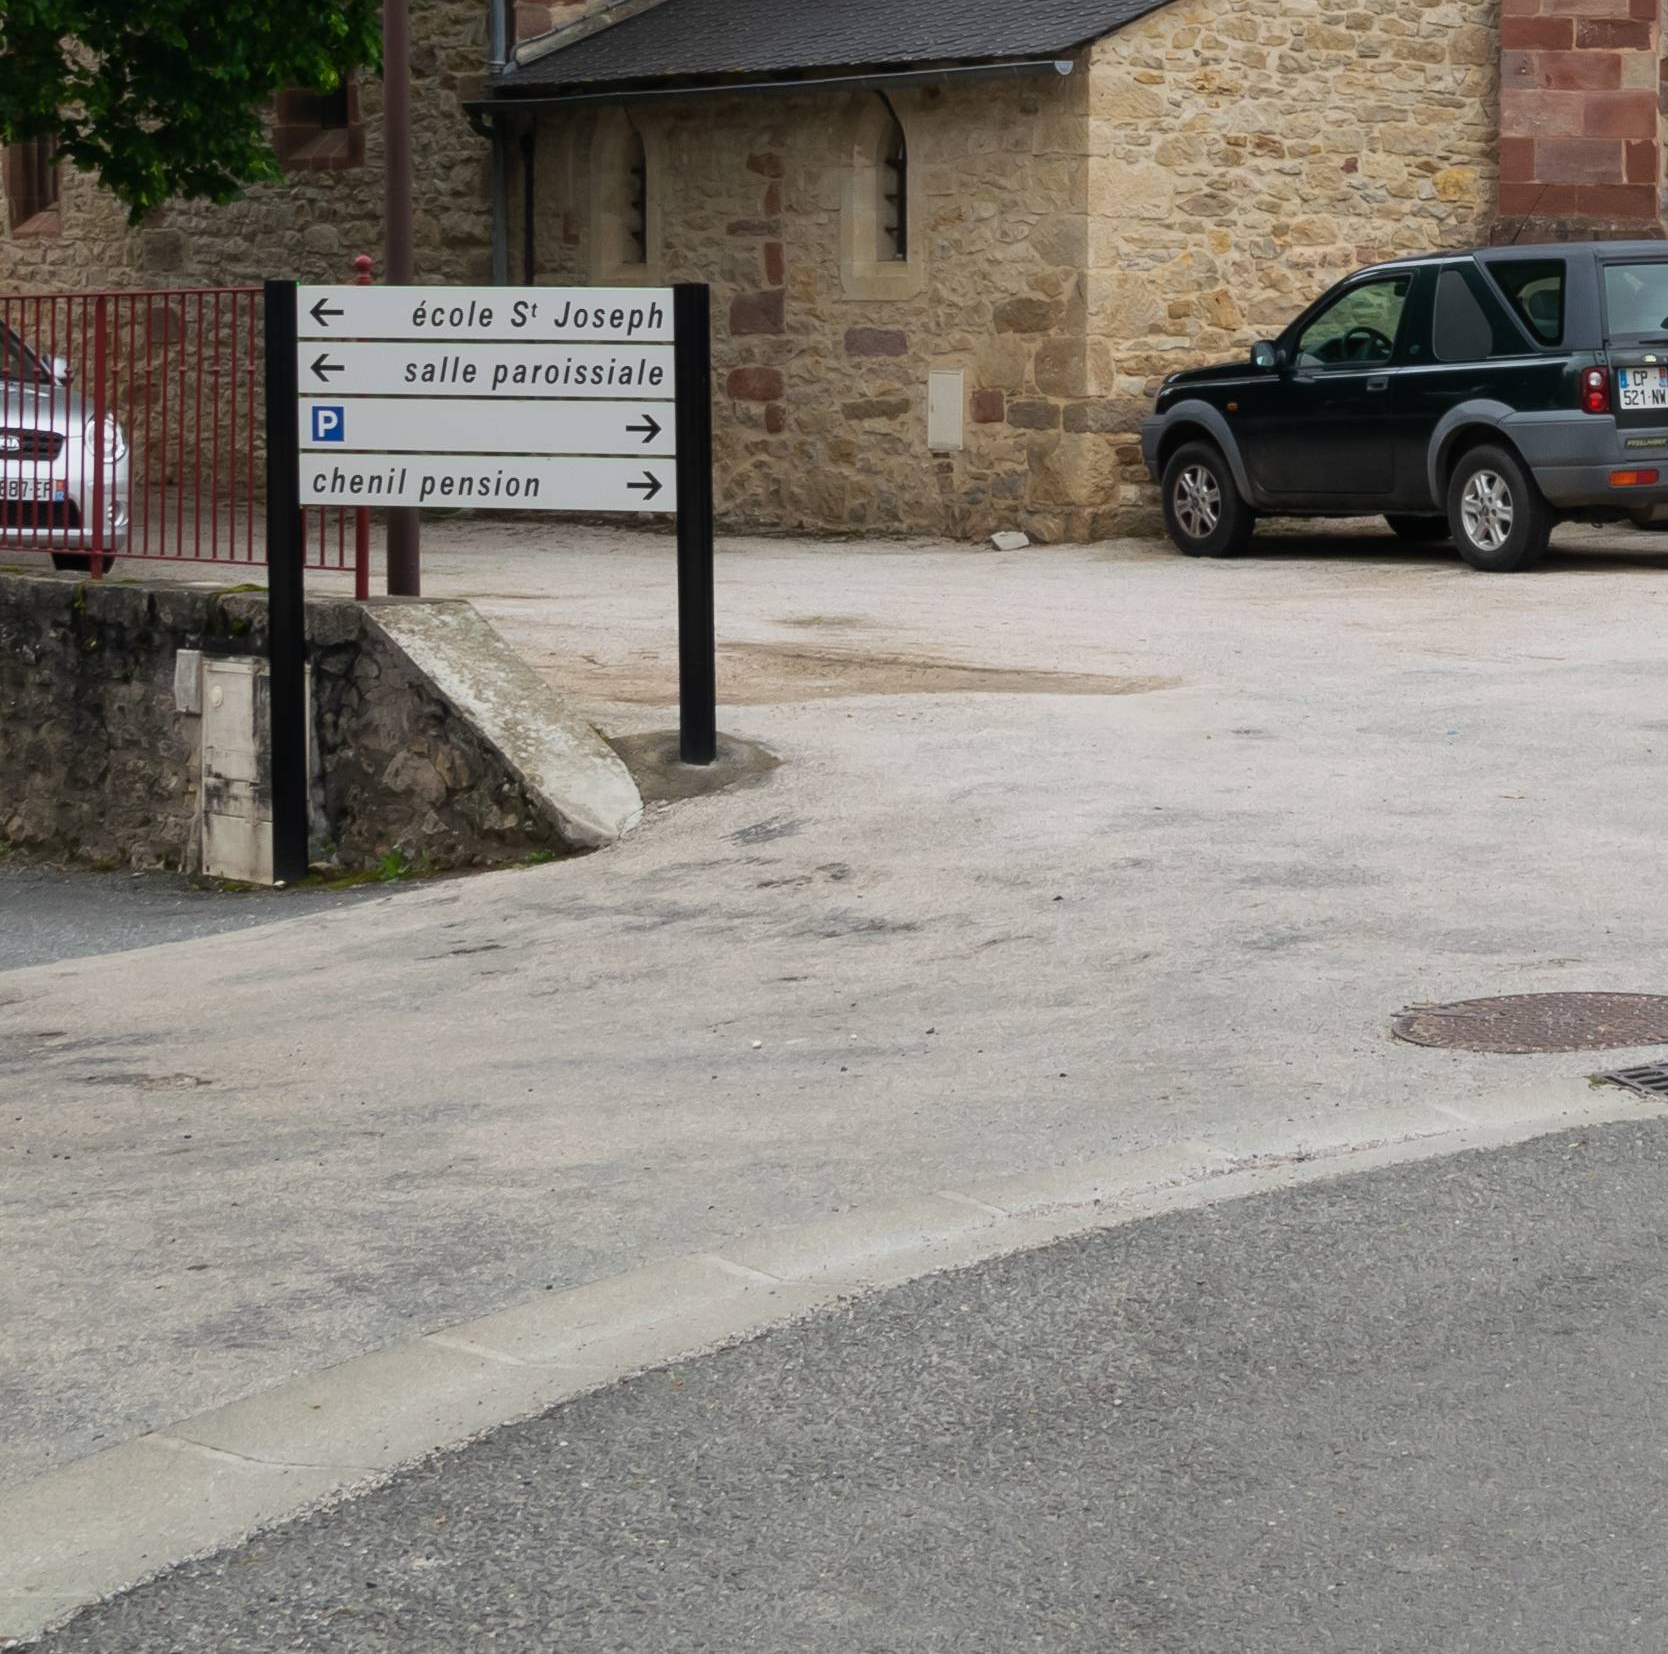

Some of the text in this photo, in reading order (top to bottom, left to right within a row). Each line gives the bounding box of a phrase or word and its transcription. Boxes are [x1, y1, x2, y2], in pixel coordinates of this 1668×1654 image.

[412, 299, 664, 336] école St Joseph
[404, 355, 664, 391] salle paroissiale
[318, 410, 338, 437] P
[312, 466, 540, 503] chenil pension
